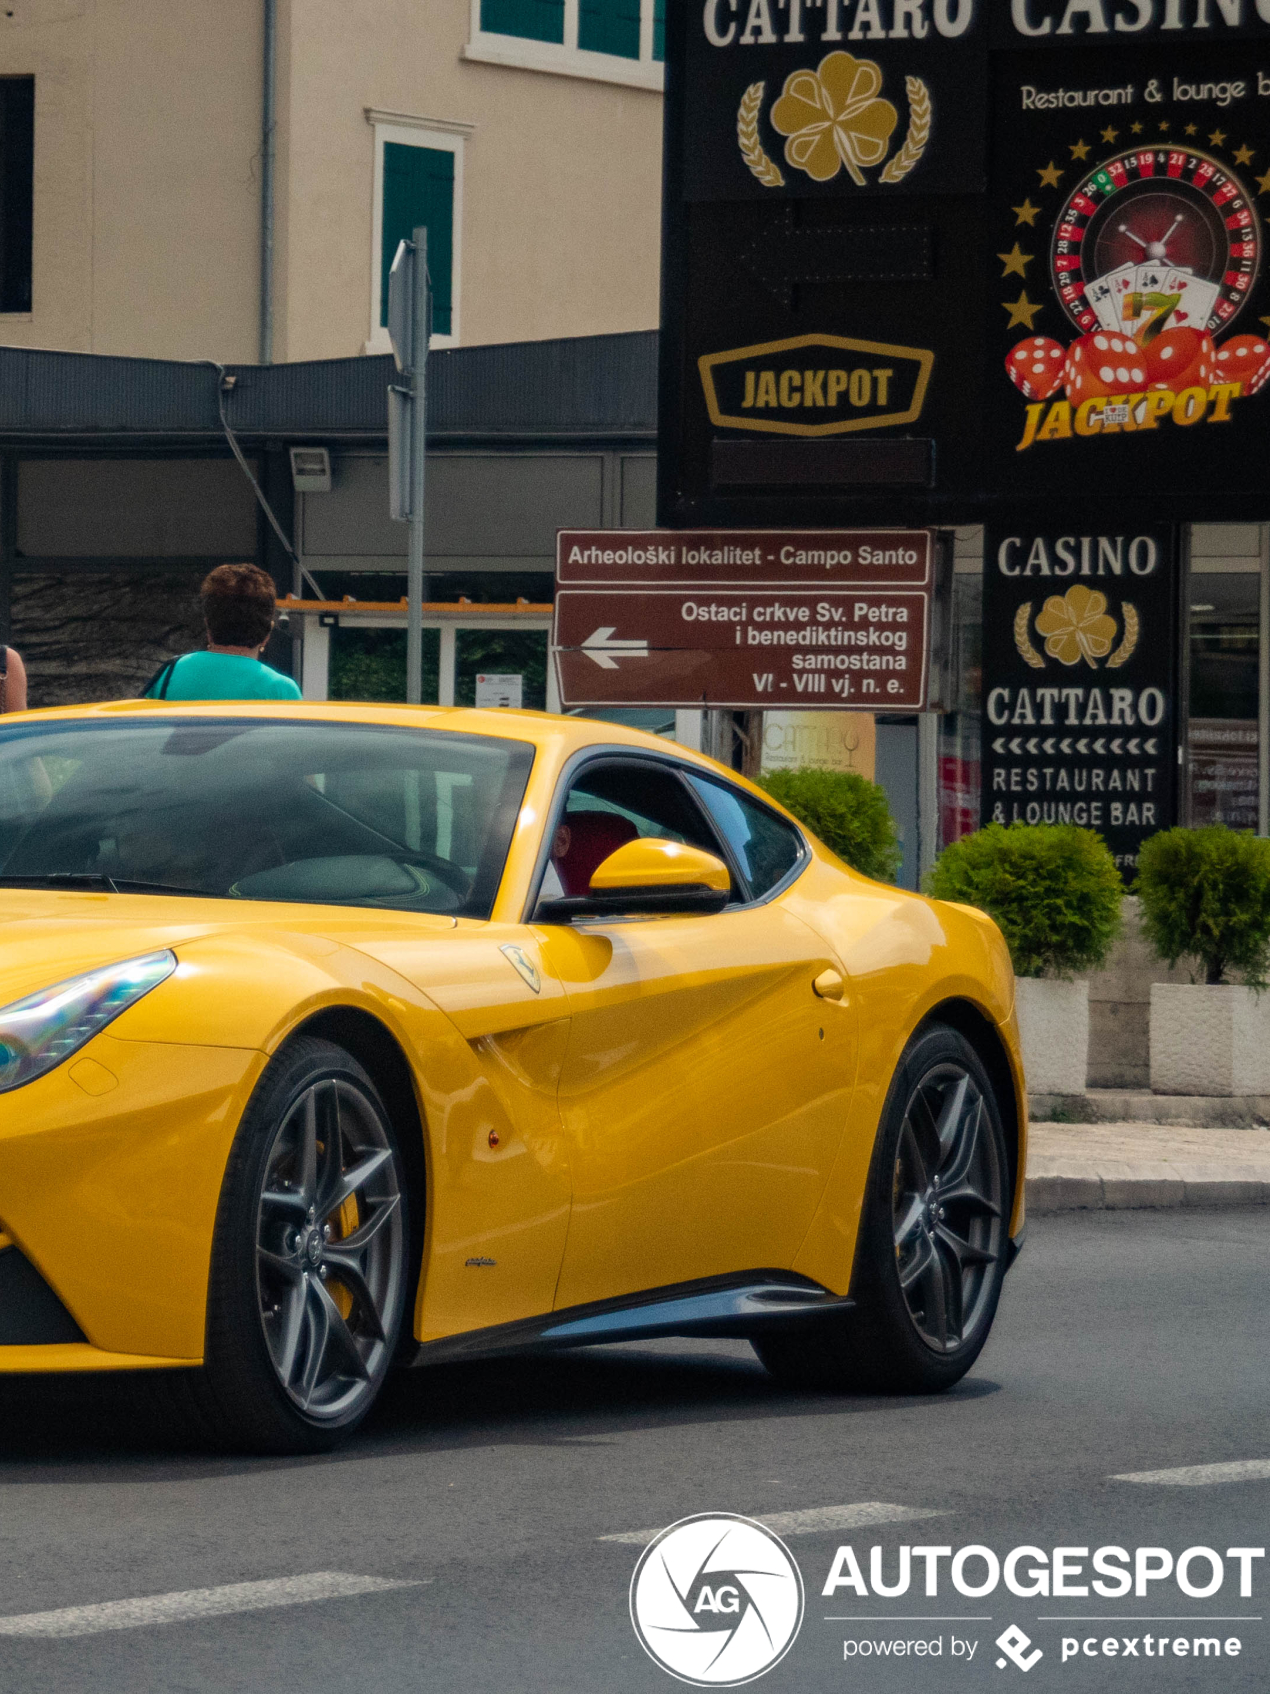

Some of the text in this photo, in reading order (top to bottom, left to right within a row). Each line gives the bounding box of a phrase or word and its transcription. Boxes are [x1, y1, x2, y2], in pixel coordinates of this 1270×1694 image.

[703, 0, 973, 47] CATTARO
[1022, 84, 1133, 110] Restaurant
[1144, 80, 1162, 102] &
[1173, 75, 1245, 108] lounge
[1122, 292, 1182, 347] 7
[742, 368, 894, 409] JACKPOT
[1016, 382, 1243, 451] JACKPOT
[568, 545, 675, 565] Arheološki
[681, 546, 761, 565] lokalitet
[780, 546, 852, 569] Campo
[857, 546, 917, 565] Santo
[997, 536, 1157, 577] CASINO
[681, 602, 908, 622] Ostaci crkve Sv. Petra
[735, 626, 908, 650] i benediktinskog
[792, 652, 907, 670] samostana
[793, 674, 826, 693] VIII
[831, 674, 855, 697] vj.
[862, 677, 880, 693] n.
[887, 677, 905, 693] e.
[986, 686, 1165, 726] CATTARO
[992, 768, 1157, 792] RESTAURANT
[992, 802, 1156, 825] & LOUNGE BAR
